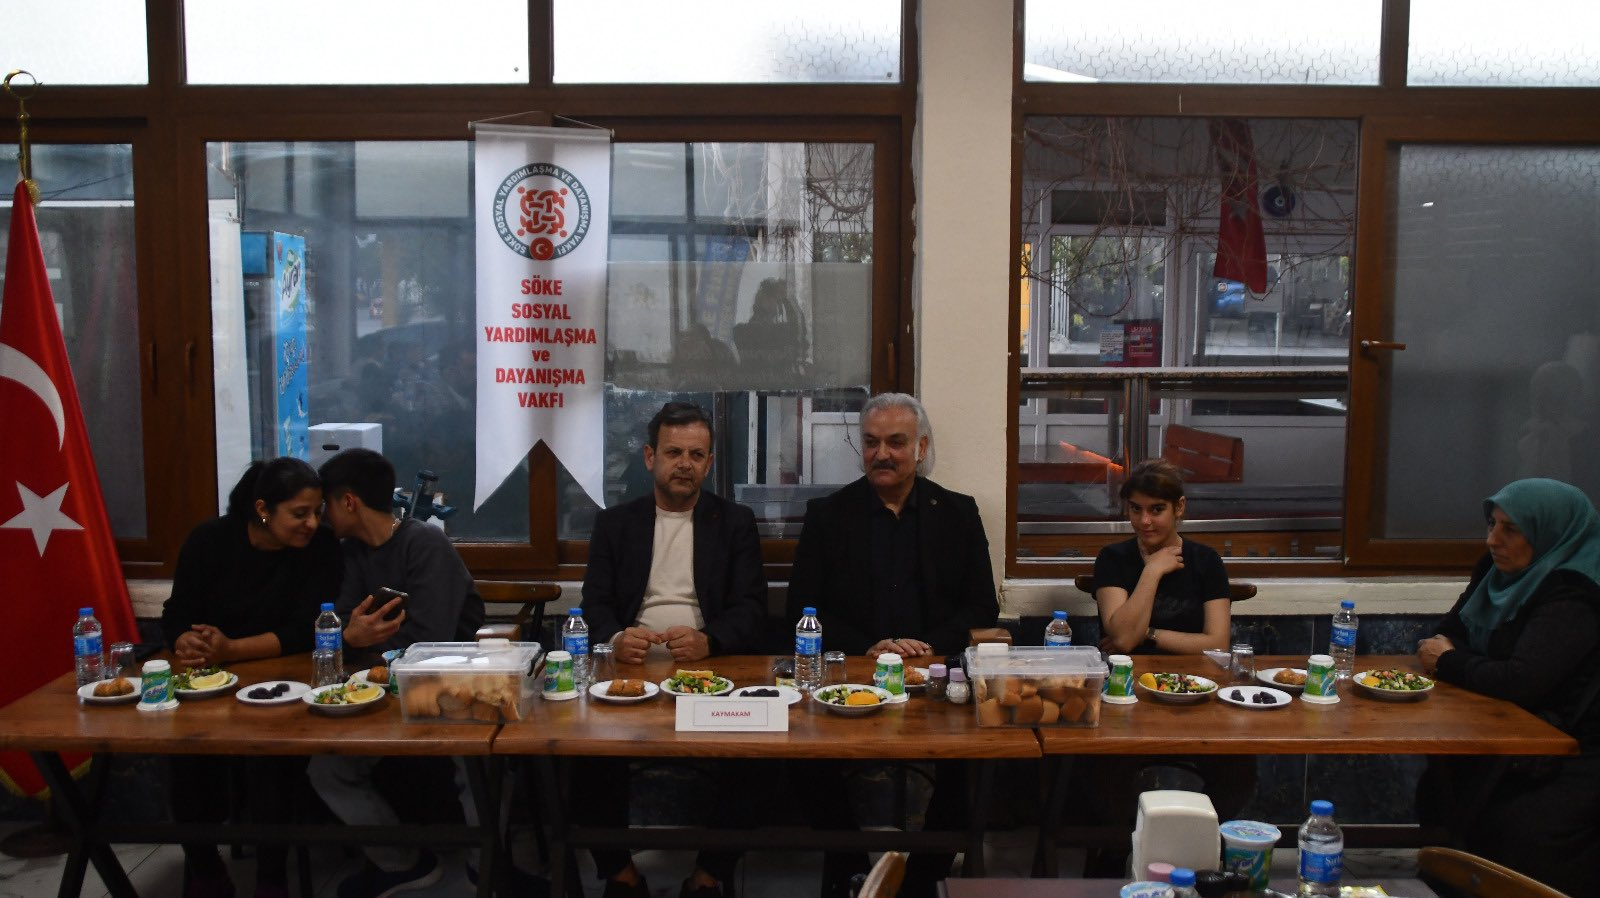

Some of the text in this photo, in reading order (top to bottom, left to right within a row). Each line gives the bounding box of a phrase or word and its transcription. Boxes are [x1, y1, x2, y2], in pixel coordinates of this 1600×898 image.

[499, 165, 560, 197] YARDIMLAŞMA
[561, 171, 573, 183] VE
[495, 198, 508, 234] SOSYAL
[570, 181, 589, 234] DAYANIŞMA
[557, 235, 582, 255] VAKFI
[521, 275, 562, 296] SÖKE
[511, 303, 571, 320] SOSYAL
[484, 327, 597, 347] YARDIMLAŞMA
[532, 349, 550, 362] ve
[495, 368, 585, 387] DAYANIŞMA
[518, 392, 564, 408] VAKFI
